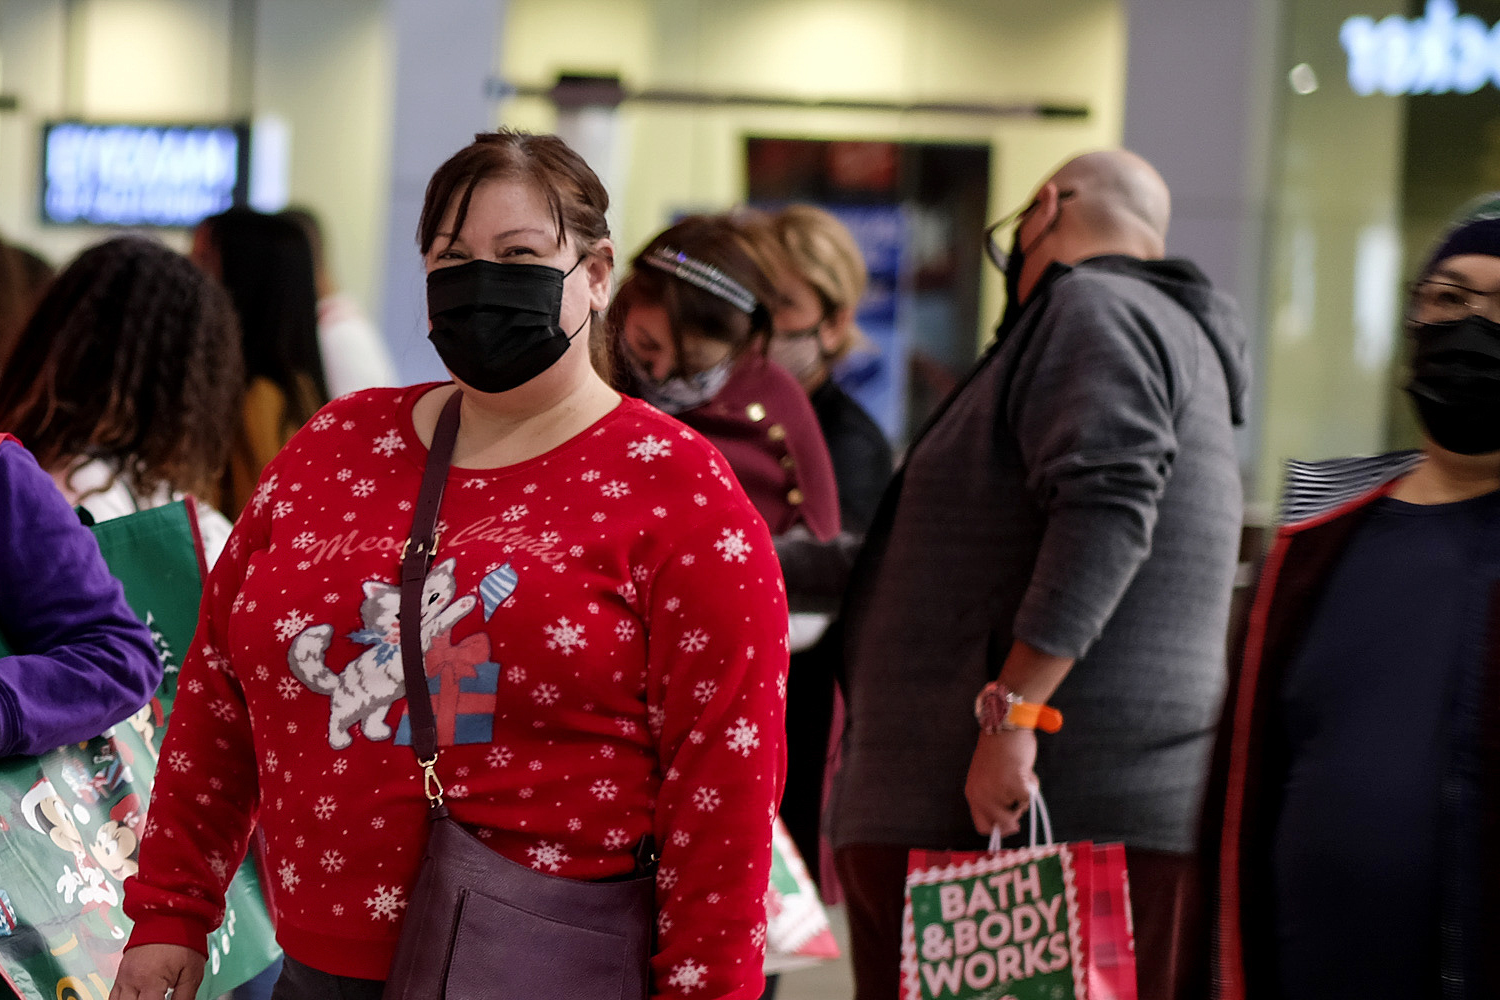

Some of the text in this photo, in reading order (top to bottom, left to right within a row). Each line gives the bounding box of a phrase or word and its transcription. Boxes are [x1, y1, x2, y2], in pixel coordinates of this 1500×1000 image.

[304, 529, 406, 565] Meo
[939, 863, 1043, 922] BATH
[921, 892, 1065, 962] &BODY
[921, 931, 1070, 998] WORKS
